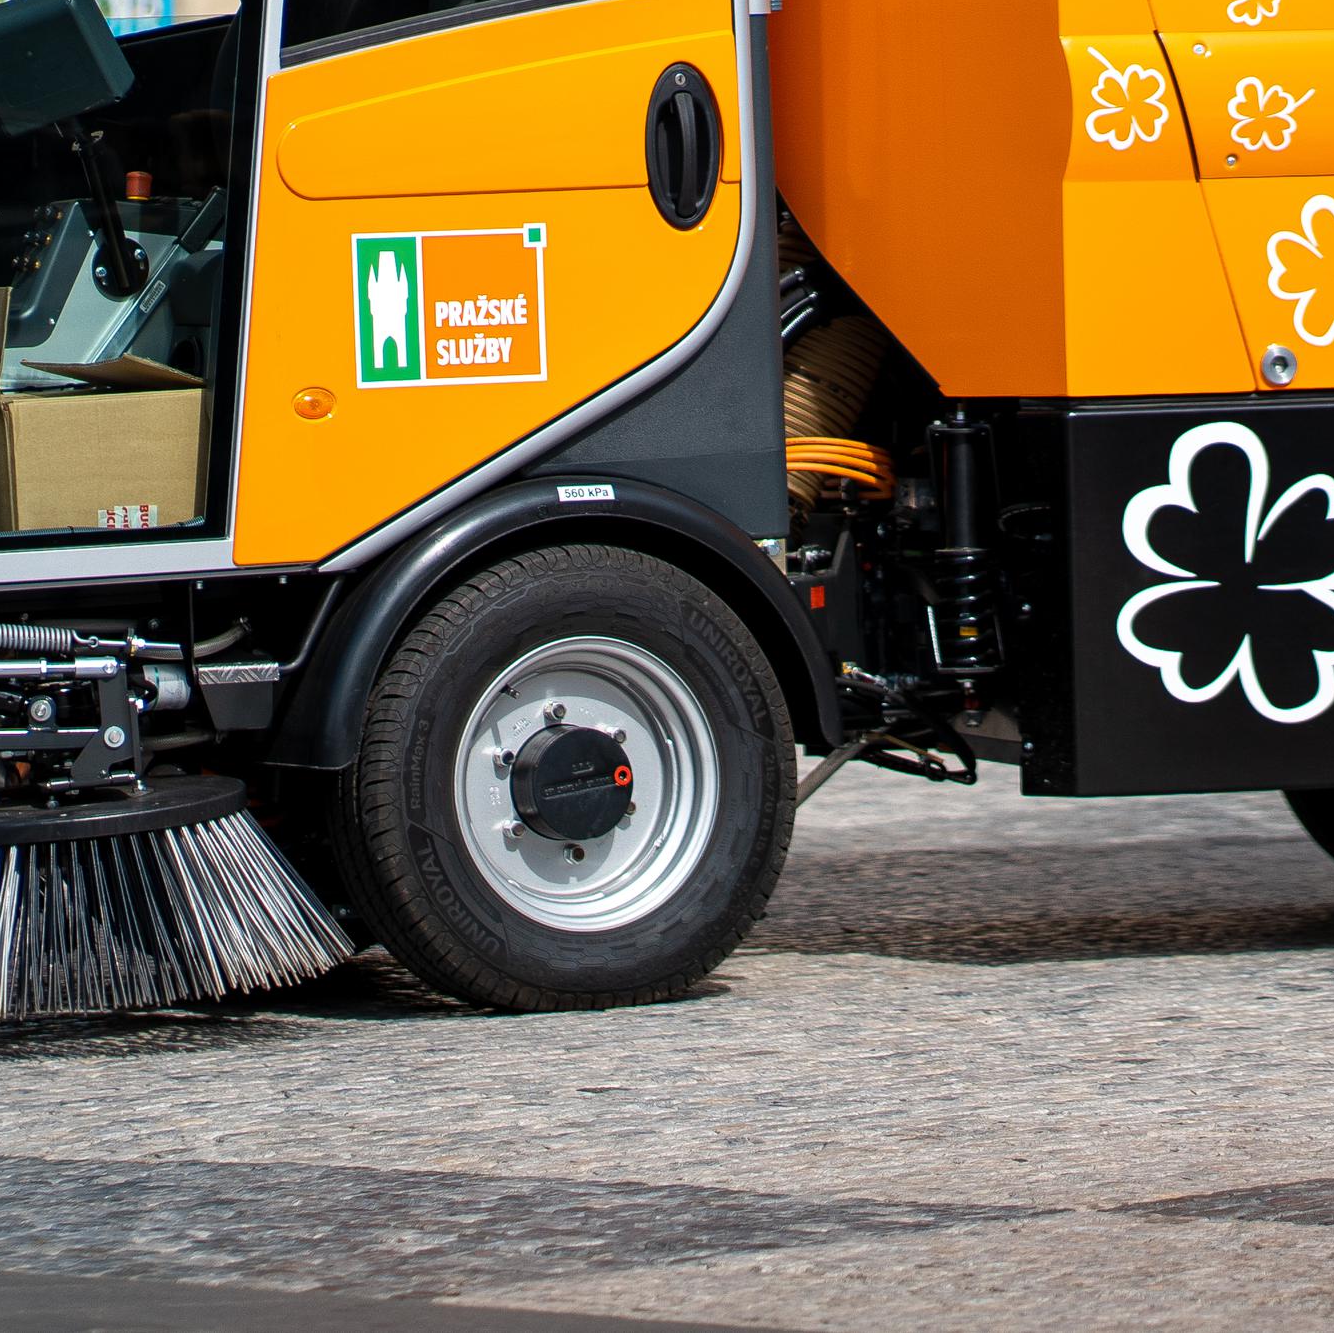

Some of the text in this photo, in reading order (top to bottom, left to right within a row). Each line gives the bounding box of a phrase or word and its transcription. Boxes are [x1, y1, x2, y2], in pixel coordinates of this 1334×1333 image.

[435, 294, 528, 327] PRAŽSKÉ
[436, 332, 513, 366] SLUŽBY
[564, 487, 609, 499] 560 kPa
[689, 609, 765, 730] UNIROYAL
[410, 720, 431, 810] RainMax 3
[416, 837, 501, 958] UNIROYAL
